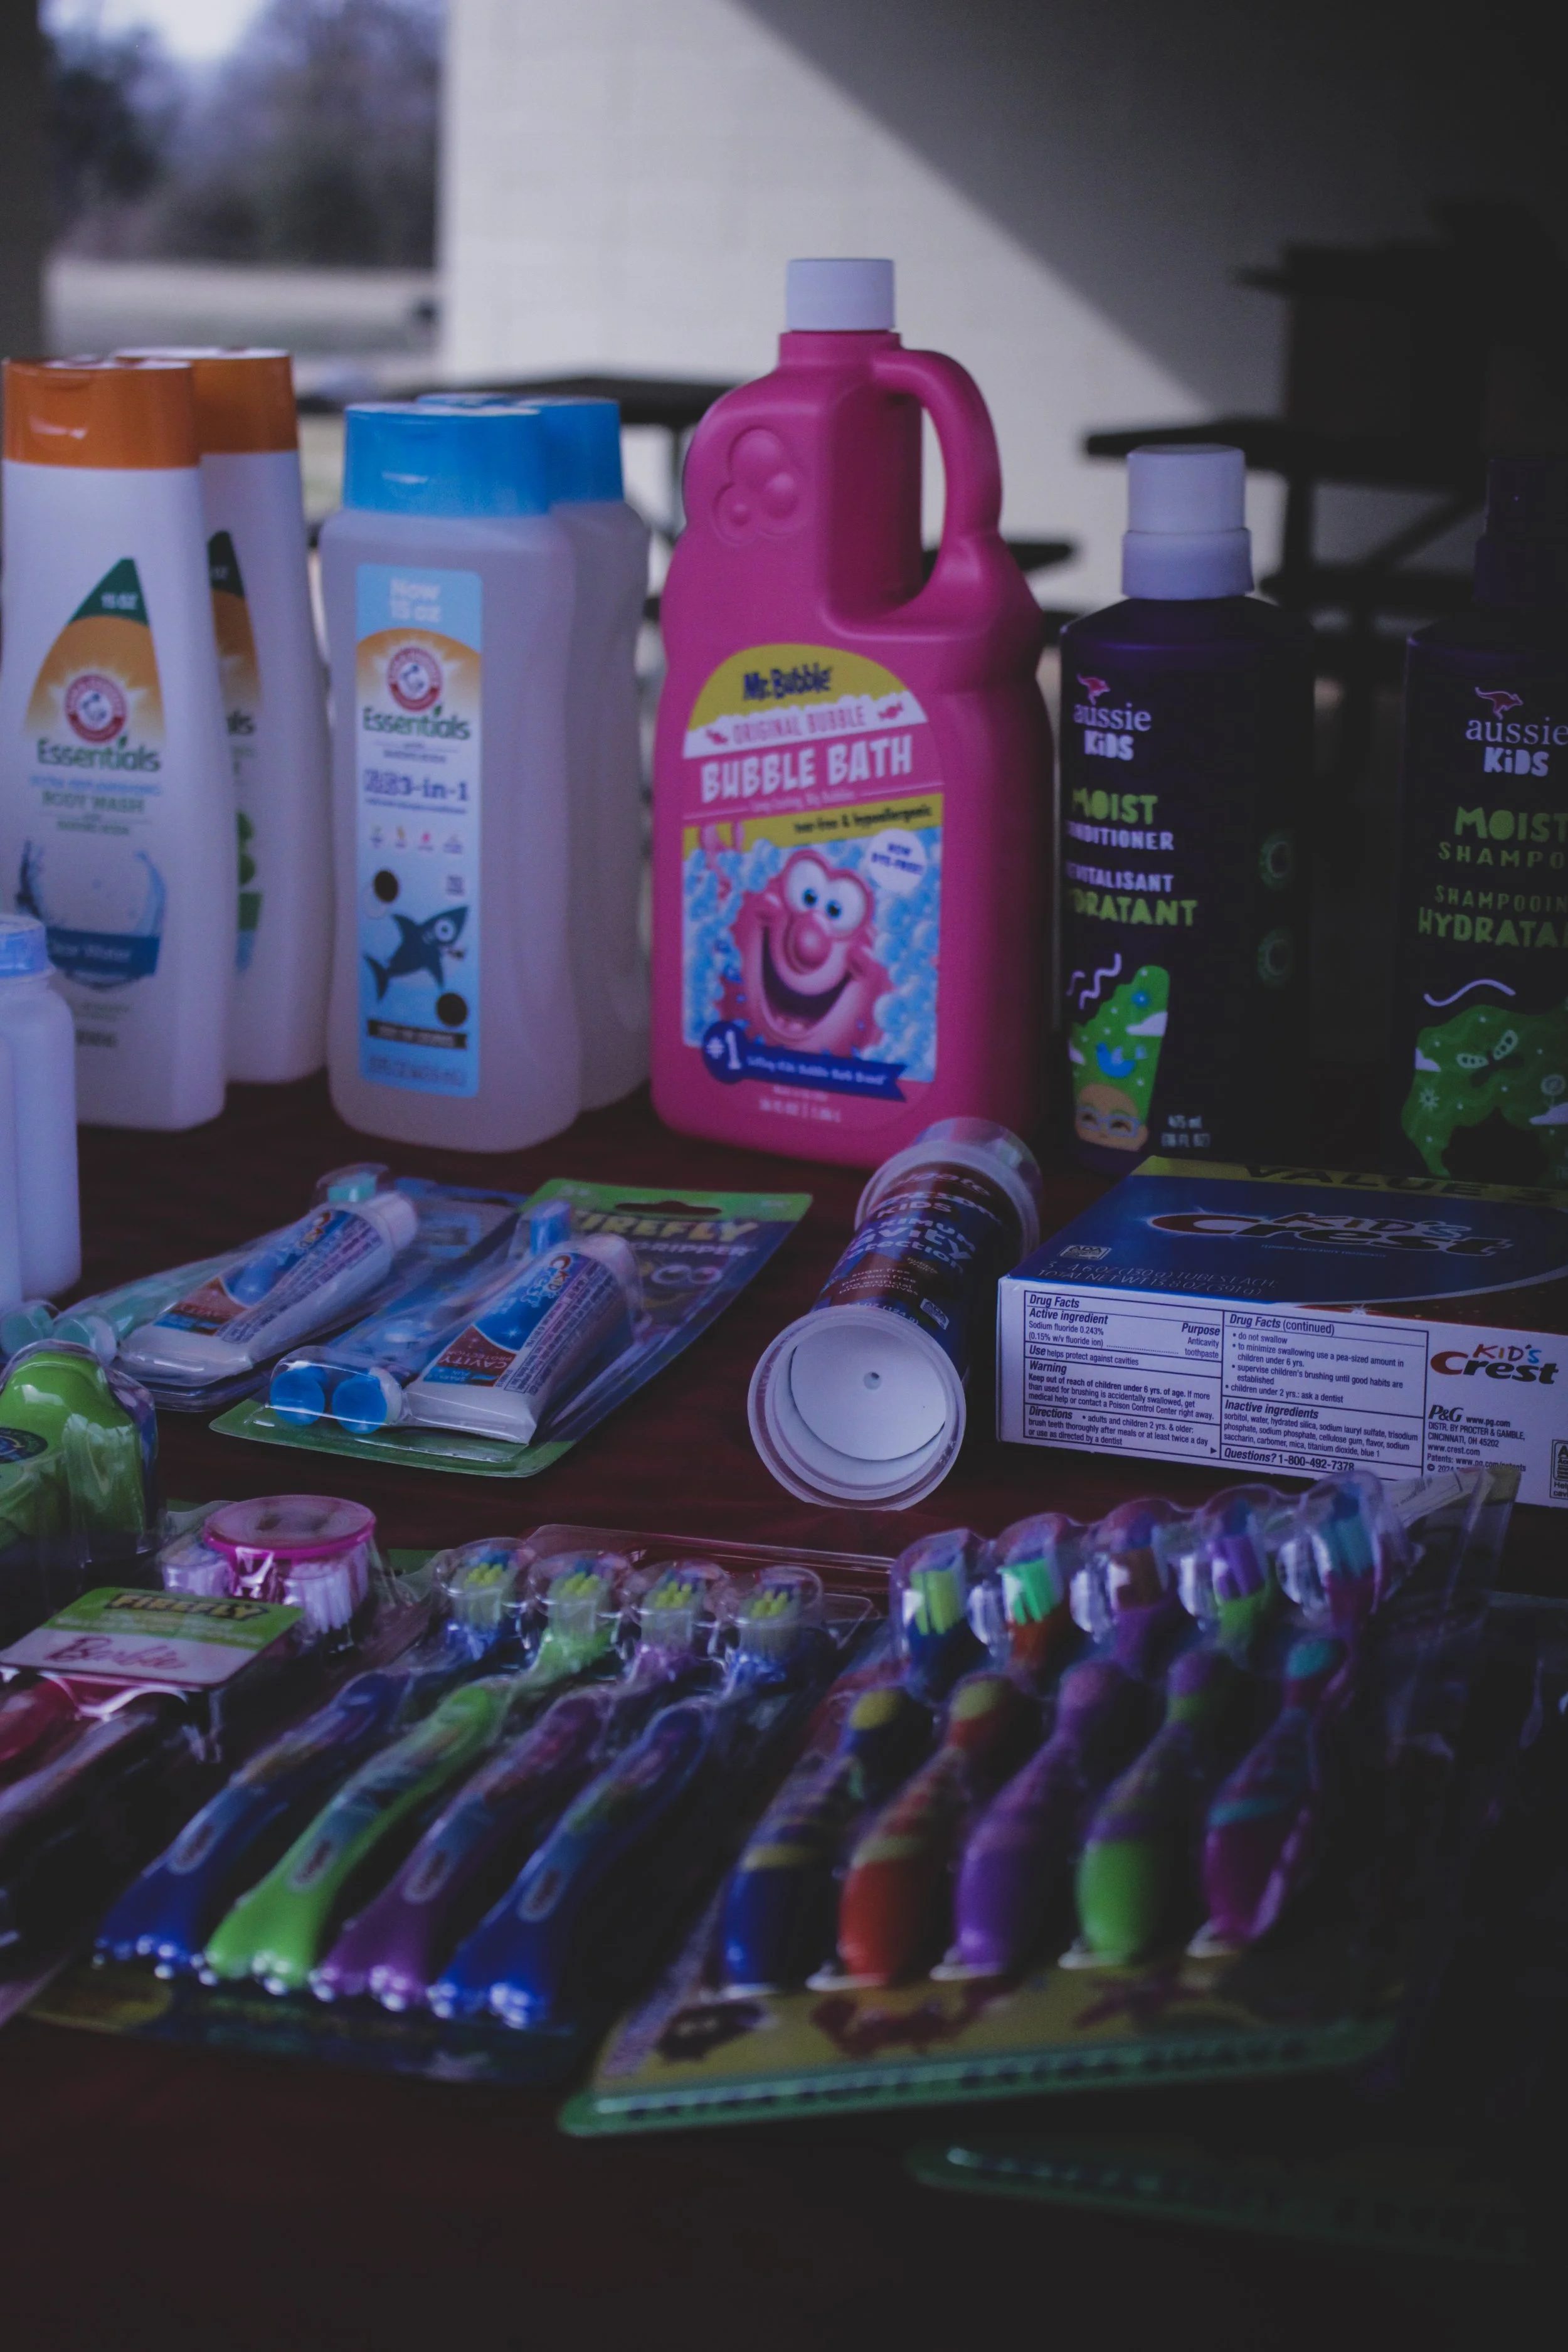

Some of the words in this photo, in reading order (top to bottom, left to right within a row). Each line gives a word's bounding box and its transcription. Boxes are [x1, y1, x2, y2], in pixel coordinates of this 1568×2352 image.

[362, 704, 470, 741] Essentials
[807, 706, 865, 733] BUBBLE
[1073, 701, 1152, 732] aussie
[1465, 716, 1568, 746] aussie
[36, 736, 161, 772] Essentials
[701, 748, 816, 804] BUBBLE
[827, 734, 913, 786] BATH
[1071, 787, 1158, 825] MOIST
[1454, 805, 1568, 843] MOIST
[1438, 841, 1568, 869] SHAMPO
[1435, 884, 1568, 913] SHAMPOOIN
[1244, 1163, 1490, 1197] VALUE
[877, 1201, 953, 1219] KIDS
[1150, 1214, 1513, 1256] Crest
[1273, 1213, 1472, 1239] KID'S
[841, 1273, 891, 1287] paraben
[893, 1274, 917, 1284] free
[851, 1268, 883, 1278] sugar
[886, 1267, 911, 1275] free
[1177, 1271, 1226, 1283] TUBES
[839, 1282, 919, 1296] preservatives
[864, 1279, 912, 1289] artificial
[1029, 1293, 1052, 1307] Drug
[1054, 1296, 1080, 1308] Facts
[1029, 1307, 1058, 1320] Active
[1060, 1312, 1108, 1325] ingredient
[1229, 1313, 1253, 1328] Drug
[1254, 1316, 1281, 1328] Facts
[1282, 1318, 1335, 1336] (continued)
[1028, 1320, 1052, 1330] Sodium
[1054, 1323, 1078, 1333] fluoride
[1079, 1325, 1104, 1335] 0.243%
[1180, 1322, 1221, 1336] Purpose
[1028, 1332, 1051, 1344] (0.15%
[1052, 1334, 1064, 1343] w/v
[1065, 1335, 1090, 1345] fluoride
[1091, 1338, 1103, 1348] ion)
[1187, 1336, 1219, 1348] Anticavity
[1237, 1332, 1247, 1340] do
[1260, 1335, 1288, 1344] swallow
[438, 1356, 508, 1370] CAVITY
[446, 1350, 513, 1362] PROTECTION
[1029, 1345, 1046, 1356] Use
[1046, 1348, 1064, 1359] helps
[1065, 1352, 1088, 1360] protect
[1089, 1354, 1113, 1363] against
[1114, 1356, 1139, 1366] cavities
[1184, 1347, 1219, 1359] toothpaste
[1473, 1343, 1542, 1364] KID'S
[1029, 1359, 1067, 1375] Warning
[1431, 1351, 1559, 1384] Crest
[1027, 1373, 1045, 1384] Keep
[1046, 1375, 1057, 1384] out
[1057, 1376, 1065, 1384] of
[1066, 1378, 1085, 1386] reach
[1086, 1379, 1093, 1387] of
[1094, 1380, 1121, 1391] children
[1123, 1384, 1143, 1392] under
[1143, 1385, 1148, 1393] 6
[1149, 1387, 1162, 1395] yrs.
[1163, 1387, 1170, 1396] of
[1171, 1389, 1185, 1398] age.
[1187, 1389, 1192, 1398] If
[1193, 1392, 1210, 1400] more
[1028, 1406, 1073, 1419] Directions
[1224, 1399, 1263, 1413] Inactive
[1264, 1403, 1319, 1419] ingredients
[1428, 1404, 1464, 1422] P&G
[1465, 1416, 1510, 1428] www.pg.com
[1428, 1421, 1448, 1431] DISTR.
[1449, 1424, 1458, 1432] BY
[1459, 1425, 1489, 1436] PROCTER
[1489, 1428, 1495, 1436] &
[1496, 1429, 1525, 1441] GAMBLE,
[1428, 1432, 1466, 1444] CINCINNATI,
[1467, 1436, 1478, 1445] OH
[1478, 1438, 1500, 1448] 45202
[1223, 1433, 1256, 1444] saccharin,
[1256, 1436, 1288, 1448] carbomer,
[1288, 1439, 1306, 1450] mica,
[1307, 1441, 1333, 1452] titanium
[1334, 1444, 1359, 1456] dioxide,
[1360, 1448, 1375, 1457] blue
[1376, 1449, 1379, 1458] 1
[1427, 1444, 1480, 1456] www.crest.com
[1224, 1447, 1277, 1463] Questions?
[1278, 1454, 1355, 1471] 1-800-492-7378
[1426, 1453, 1453, 1463] Patents:
[105, 1592, 269, 1621] FIREFLY
